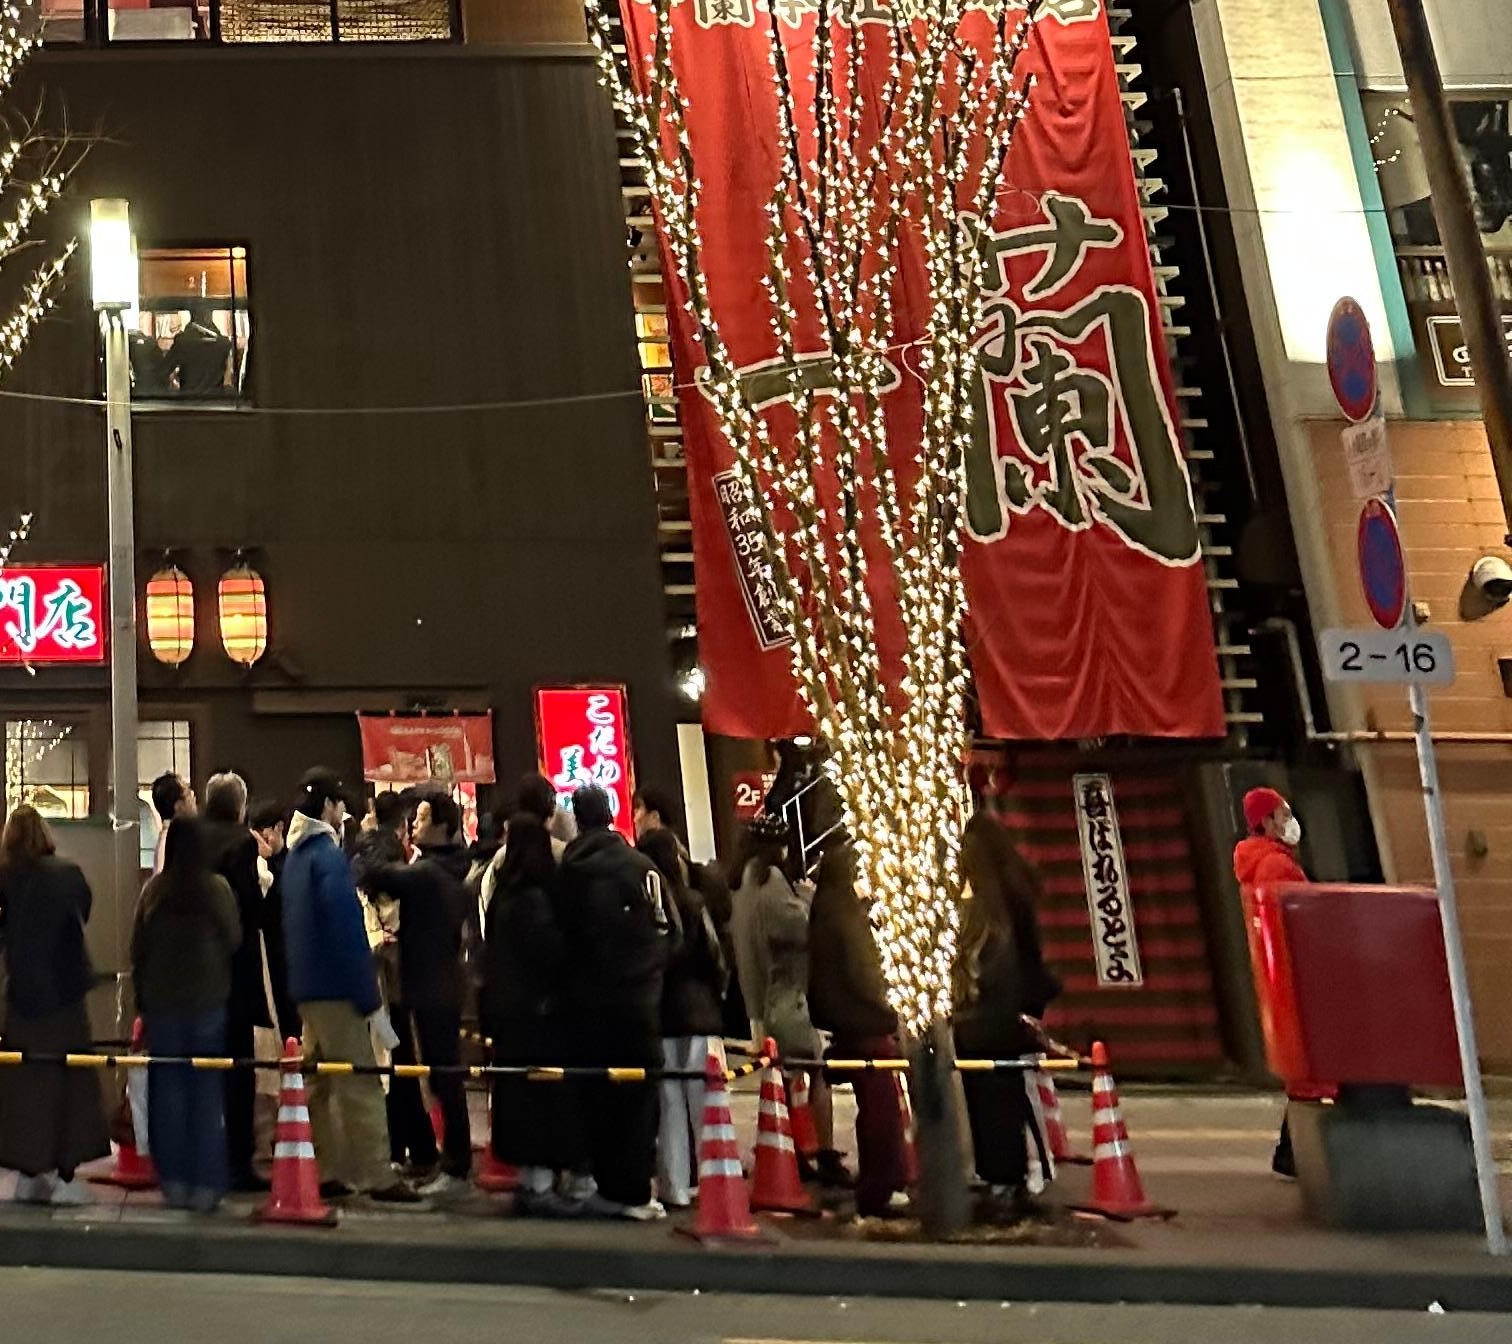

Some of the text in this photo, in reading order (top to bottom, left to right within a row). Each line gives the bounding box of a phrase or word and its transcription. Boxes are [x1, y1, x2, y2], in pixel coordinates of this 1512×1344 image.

[693, 189, 1202, 568] 一蘭
[1339, 641, 1437, 673] 2-16
[736, 782, 761, 807] 2F
